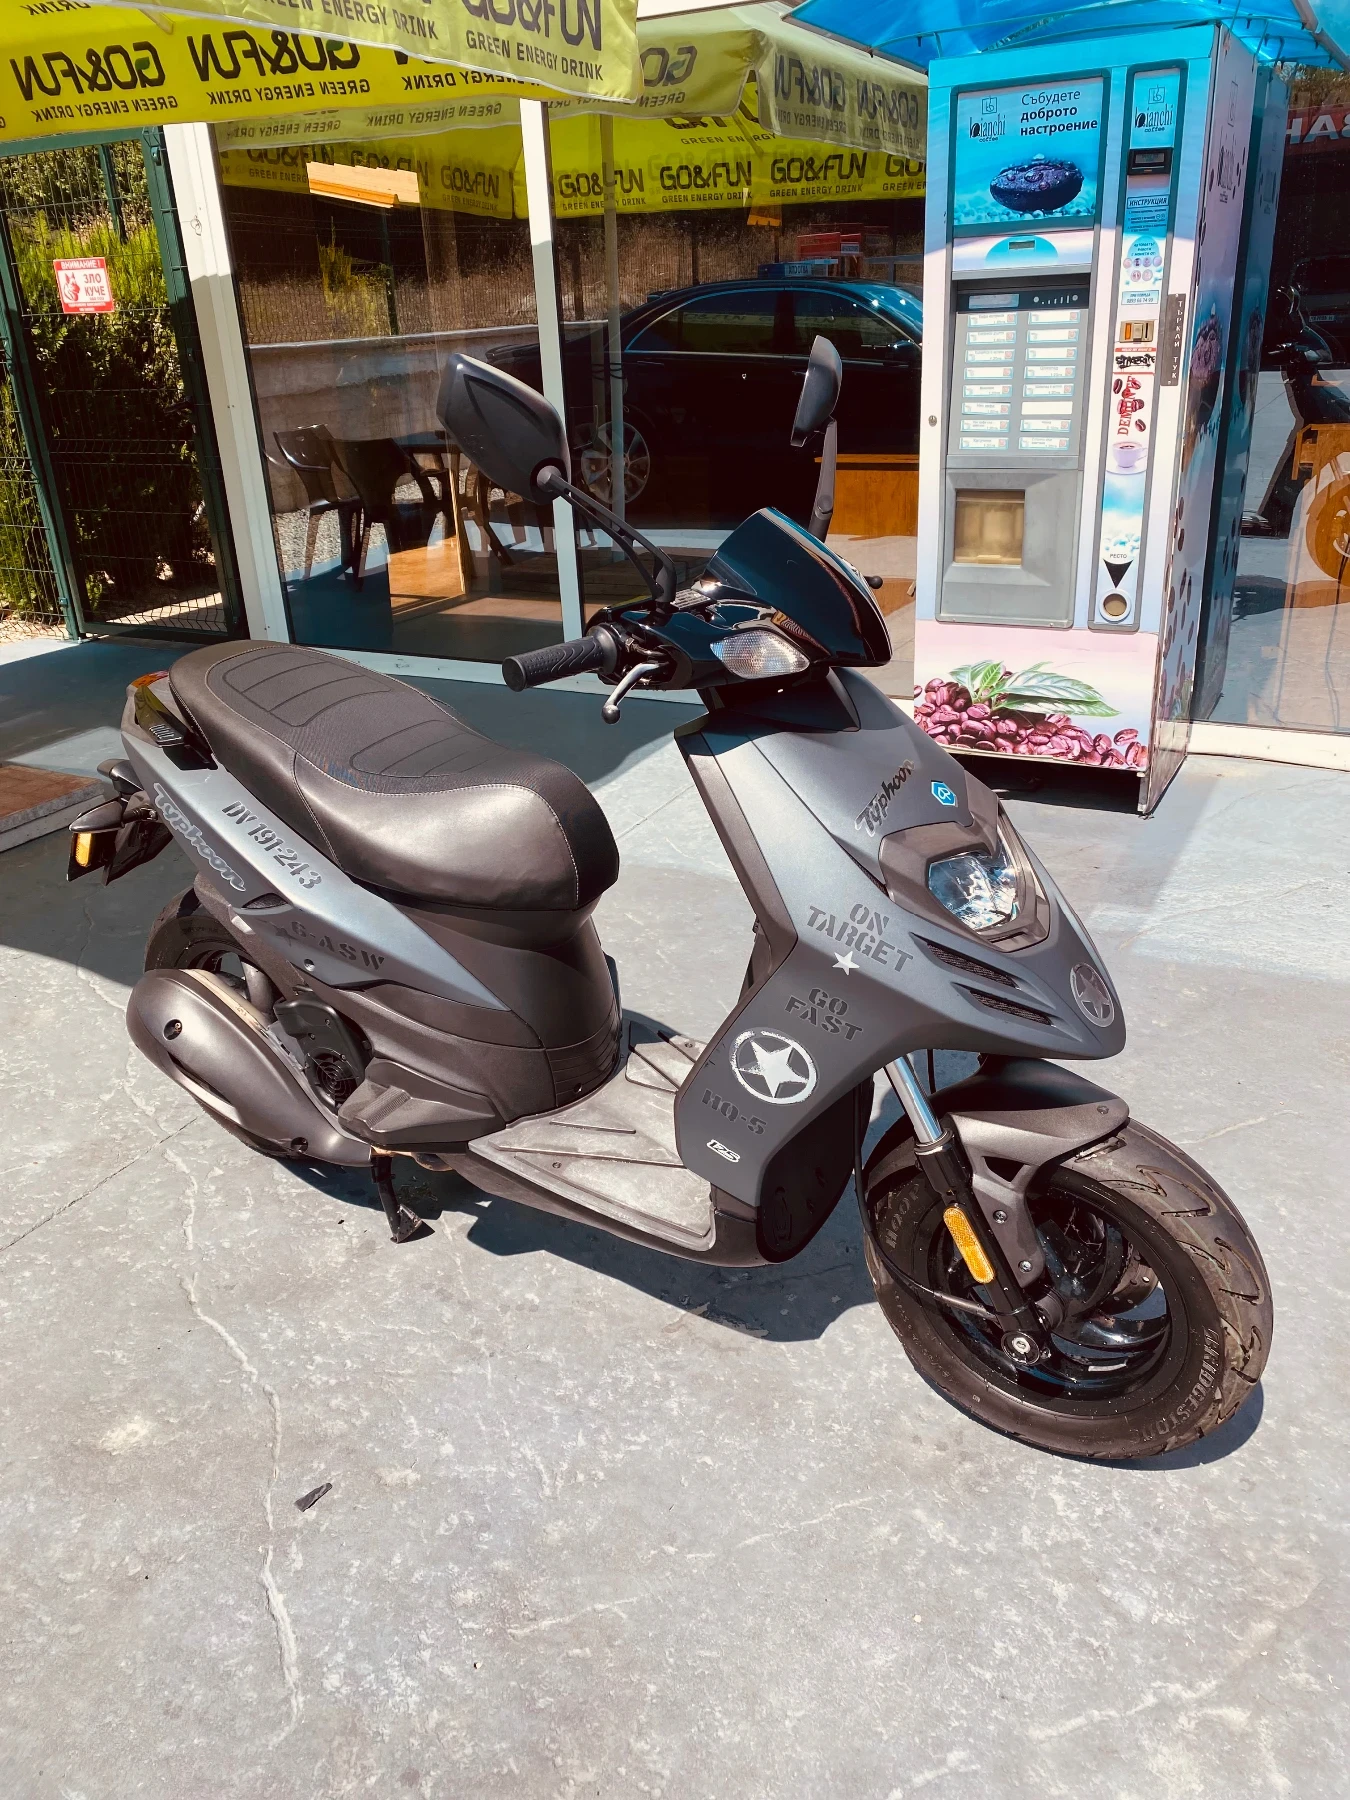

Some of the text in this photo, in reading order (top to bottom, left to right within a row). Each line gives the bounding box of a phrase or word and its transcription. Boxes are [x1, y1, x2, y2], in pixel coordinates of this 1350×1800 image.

[392, 8, 438, 40] DRINK
[466, 30, 511, 58] GREEN
[517, 42, 558, 71] ENERGY
[561, 57, 603, 81] DRINK
[1021, 90, 1081, 107] Събудете
[970, 113, 1005, 138] bianchi
[1021, 106, 1078, 123] доброто
[1135, 103, 1173, 128] bianchi
[681, 136, 724, 145] GREEN
[1020, 120, 1098, 136] настроение
[249, 168, 307, 184] GREEN ENERG
[660, 161, 752, 190] GO&FUN
[770, 152, 867, 184] GO&FUN
[441, 165, 500, 198] GO&FUN
[770, 184, 862, 197] GREEN ENERGY DRINK
[883, 182, 913, 191] GREEN
[562, 202, 588, 211] GREEN
[622, 197, 646, 206] DRINK
[662, 194, 689, 203] GREEN
[691, 193, 724, 202] ENERGY
[1129, 198, 1167, 206] ИНСТРУКЦИЯ
[83, 273, 101, 284] ЗЛО
[85, 286, 106, 296] КУЧЕ
[855, 759, 915, 837] Typhoon
[222, 800, 322, 889] DV 191-243
[850, 903, 890, 935] ON
[807, 905, 914, 972] TARGET
[808, 988, 848, 1016] GO
[785, 996, 863, 1040] FAST
[701, 1088, 767, 1135] HQ-5
